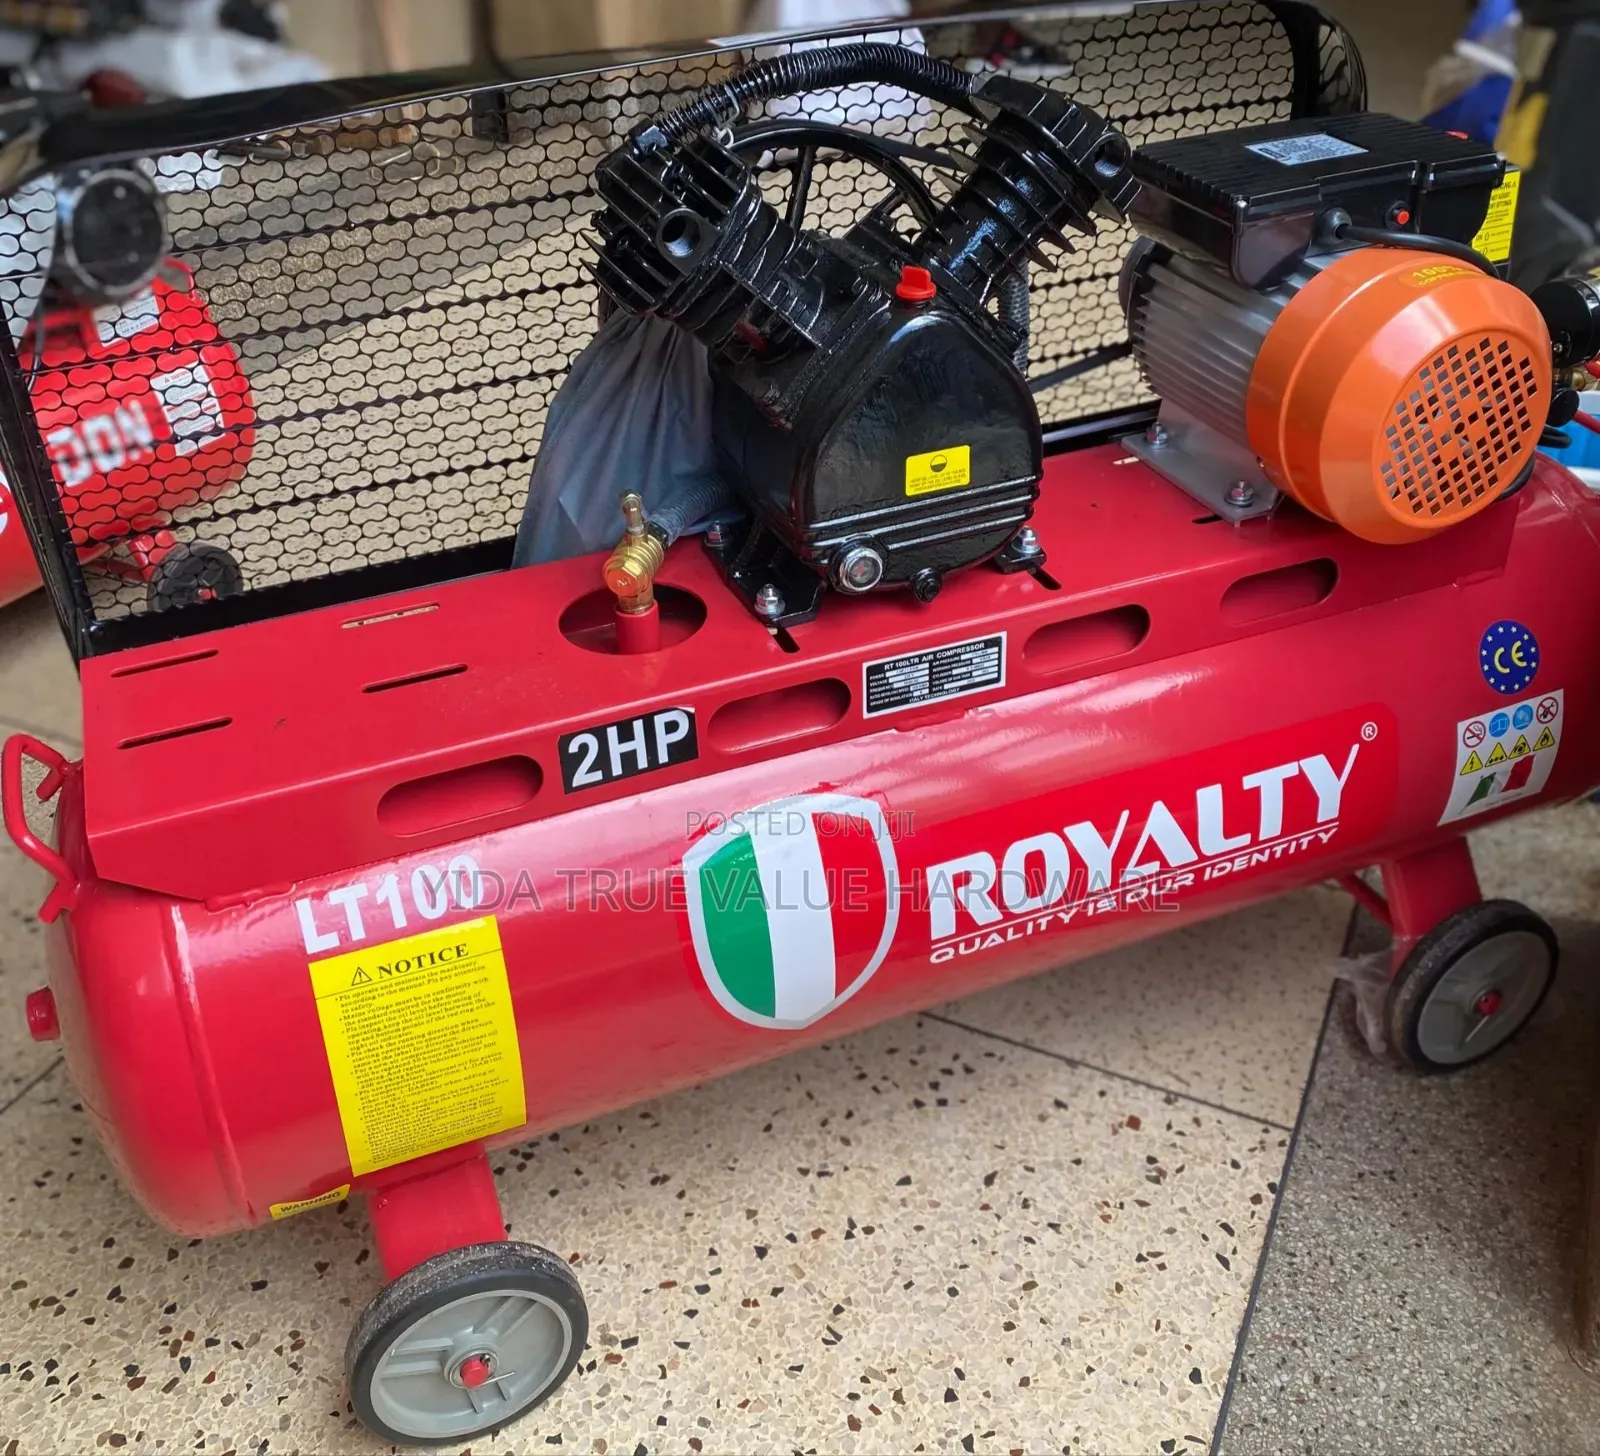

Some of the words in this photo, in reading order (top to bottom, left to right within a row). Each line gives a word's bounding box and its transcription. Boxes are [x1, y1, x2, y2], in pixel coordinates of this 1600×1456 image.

[884, 662, 892, 670] RT
[895, 656, 919, 668] 100LTR
[921, 653, 933, 662] AIR
[936, 642, 984, 659] COMPRESSOR
[1494, 640, 1527, 674] CE
[568, 709, 690, 788] 2HP
[925, 743, 1360, 942] ROYALTY
[295, 854, 485, 955] LT100
[929, 907, 1083, 964] QUALITY
[1086, 895, 1118, 917] IS
[1126, 870, 1195, 905] OUR
[1204, 827, 1339, 882] IDENTITY
[377, 943, 469, 979] NOTICE
[280, 1191, 341, 1212] WARNING
